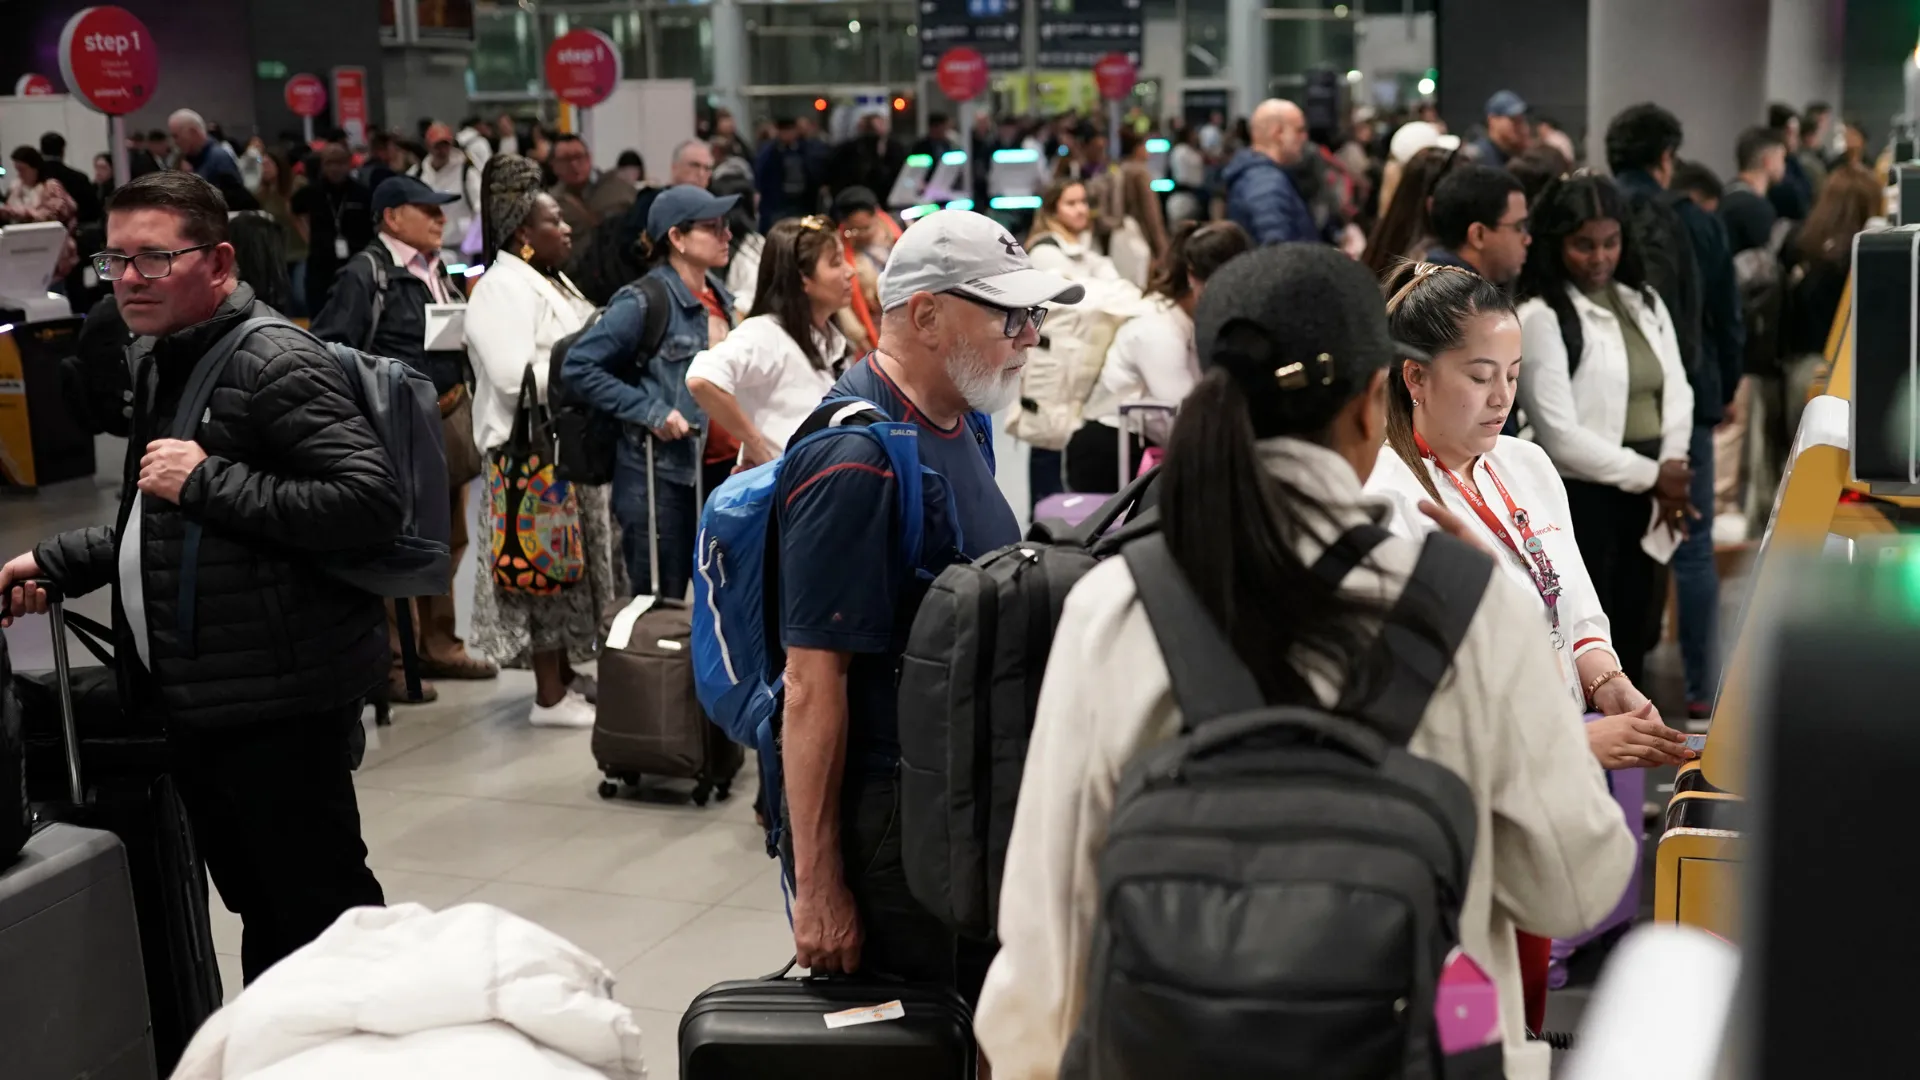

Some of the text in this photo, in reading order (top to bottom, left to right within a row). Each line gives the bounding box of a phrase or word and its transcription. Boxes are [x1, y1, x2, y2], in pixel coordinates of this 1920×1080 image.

[84, 30, 141, 57] step 1
[556, 47, 594, 67] step
[1534, 526, 1552, 536] ianca
